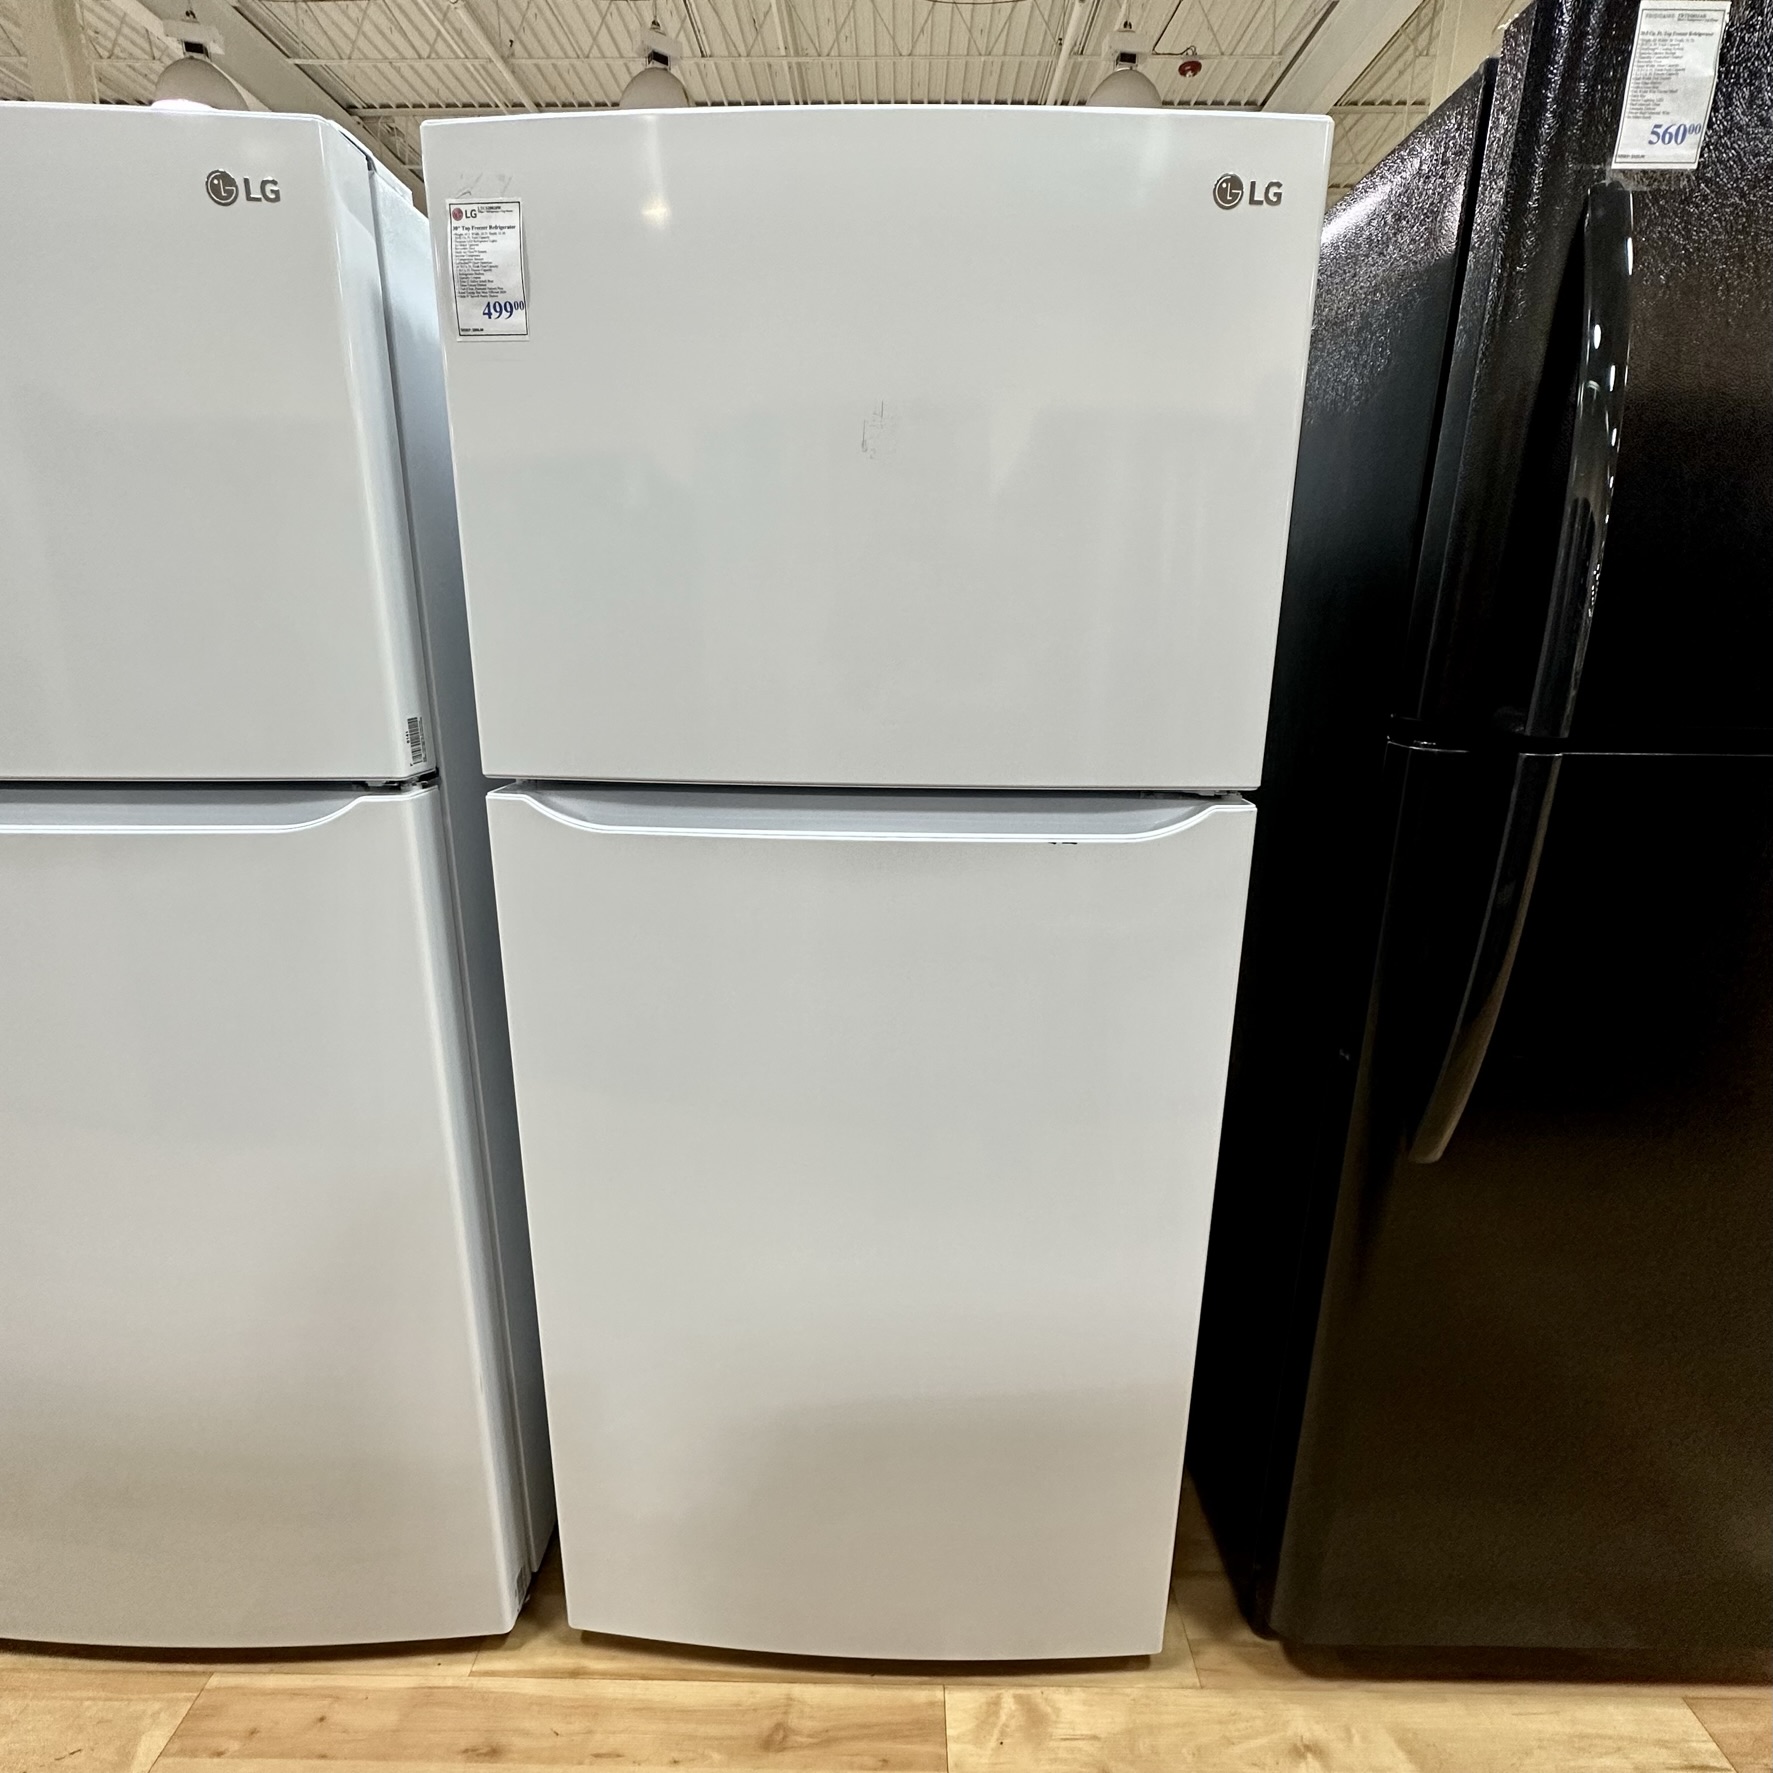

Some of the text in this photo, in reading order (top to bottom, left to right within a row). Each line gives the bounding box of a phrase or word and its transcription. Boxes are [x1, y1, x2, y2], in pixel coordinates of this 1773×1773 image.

[243, 176, 281, 203] LG
[1249, 180, 1283, 206] LG
[464, 209, 477, 219] LG
